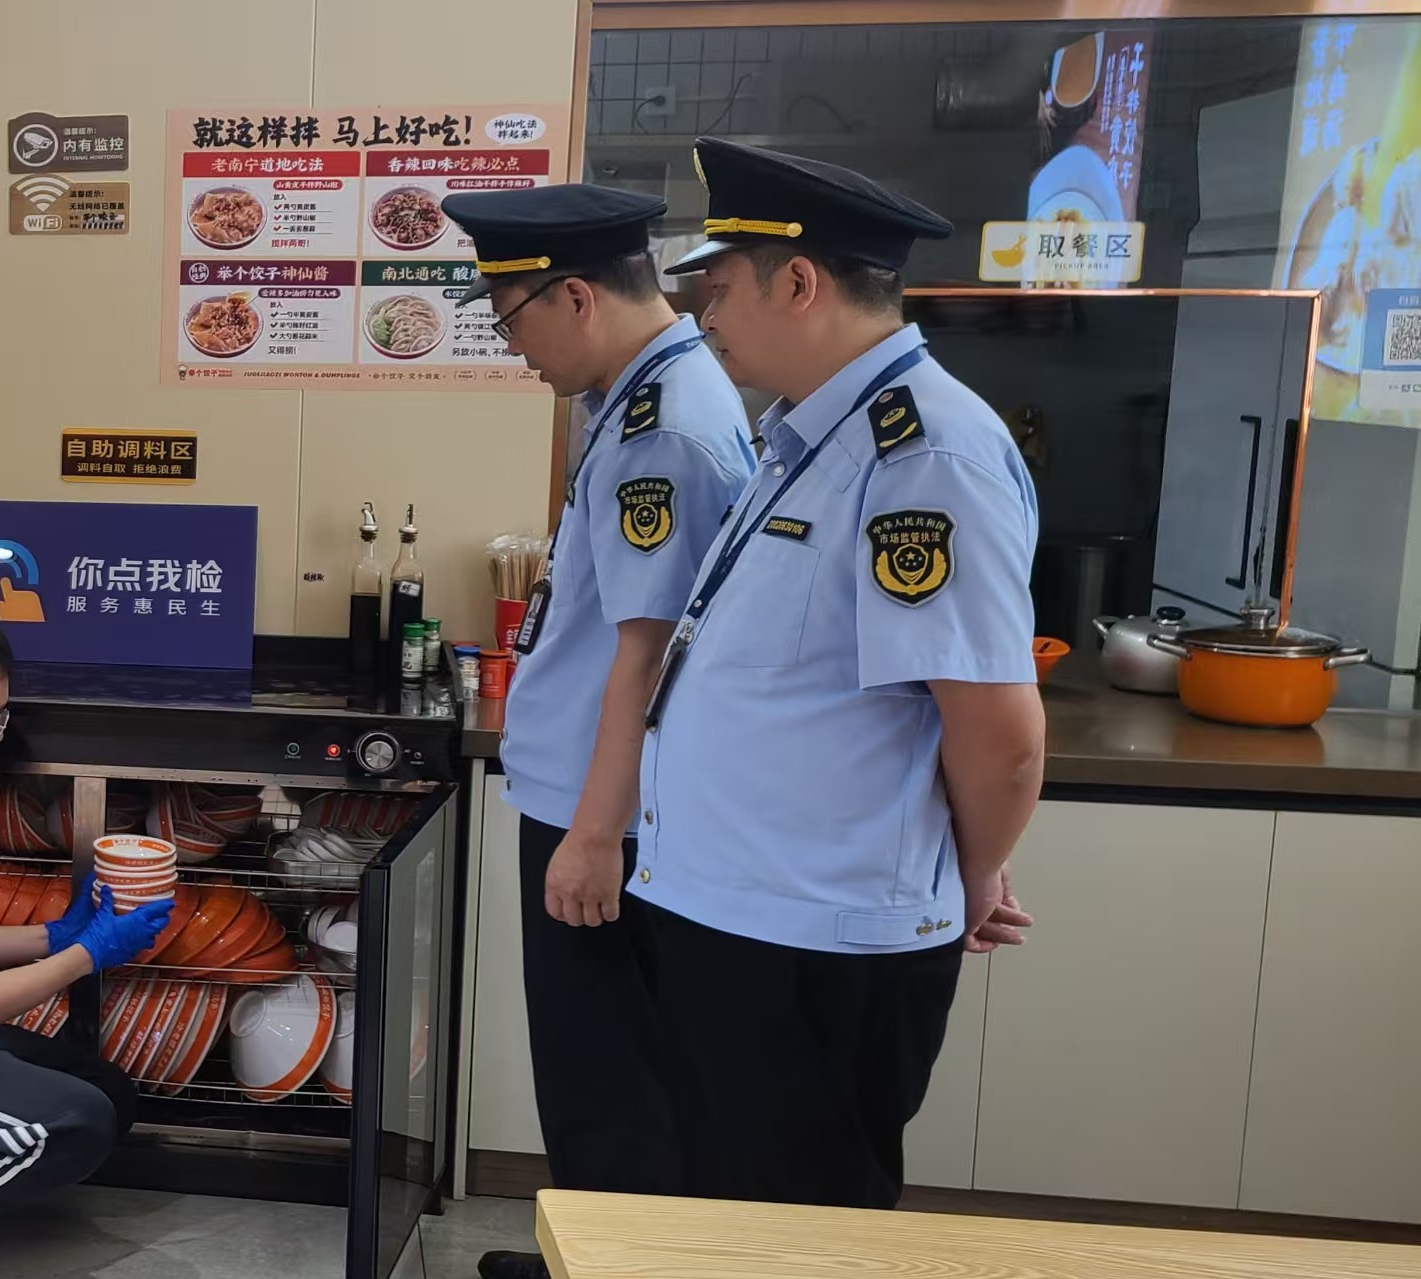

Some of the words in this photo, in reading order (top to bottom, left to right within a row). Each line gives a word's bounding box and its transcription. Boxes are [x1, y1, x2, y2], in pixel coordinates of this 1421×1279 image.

[192, 116, 321, 149] 就这样拌
[332, 114, 471, 147] 马上好吃!
[494, 120, 537, 129] 神仙吃法
[498, 130, 533, 139] 拌起来!
[63, 137, 124, 152] 内有监控
[211, 157, 324, 172] 老南宁道地吃法
[388, 156, 520, 172] 香辣回味吃辣必点
[27, 218, 59, 228] WiFi
[1038, 233, 1132, 258] 取餐区
[216, 265, 329, 281] 举个饺子神仙酱
[382, 266, 446, 281] 南北通吃
[67, 438, 193, 461] 自助调料区
[77, 462, 126, 473] 调料自取
[133, 463, 182, 475] 拒绝浪费
[872, 516, 946, 535] 中华人民共和国
[879, 531, 940, 544] 市场监管执法
[67, 556, 223, 594] 你点我检
[66, 596, 221, 617] 服务惠民生
